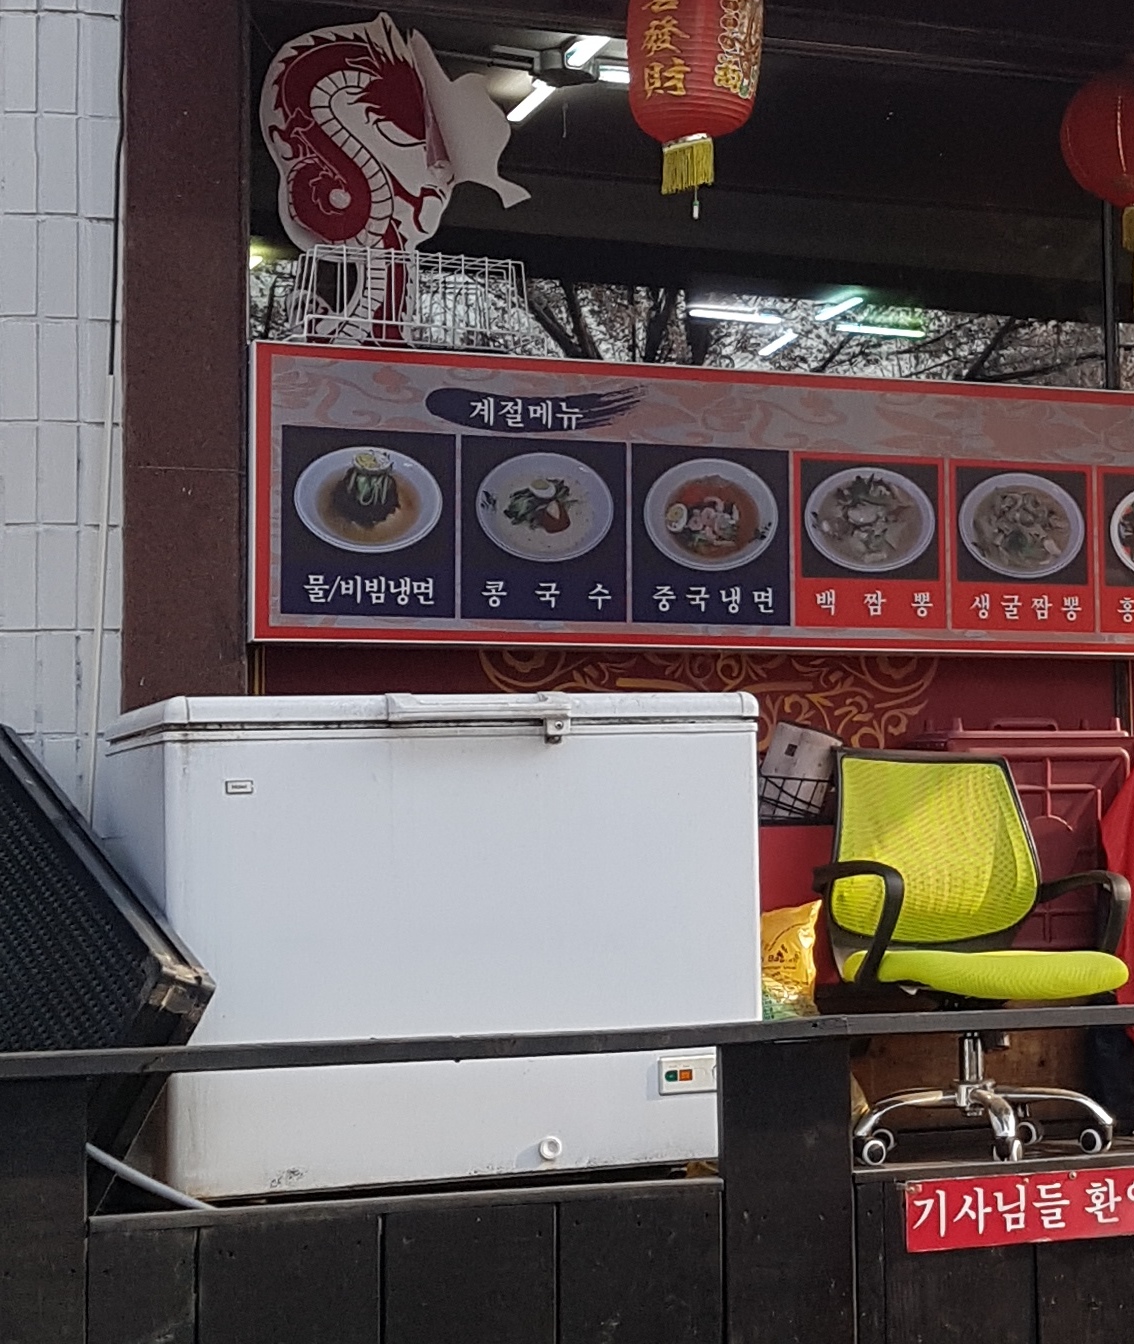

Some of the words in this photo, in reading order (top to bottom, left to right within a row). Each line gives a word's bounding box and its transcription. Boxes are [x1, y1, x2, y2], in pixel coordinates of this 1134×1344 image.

[469, 396, 585, 430] 계절메뉴
[303, 574, 435, 605] 물/비빔냉면
[652, 585, 775, 613] 중국냉면
[969, 594, 1083, 622] 생굴짬뽕
[913, 1183, 1070, 1237] 기사님들
